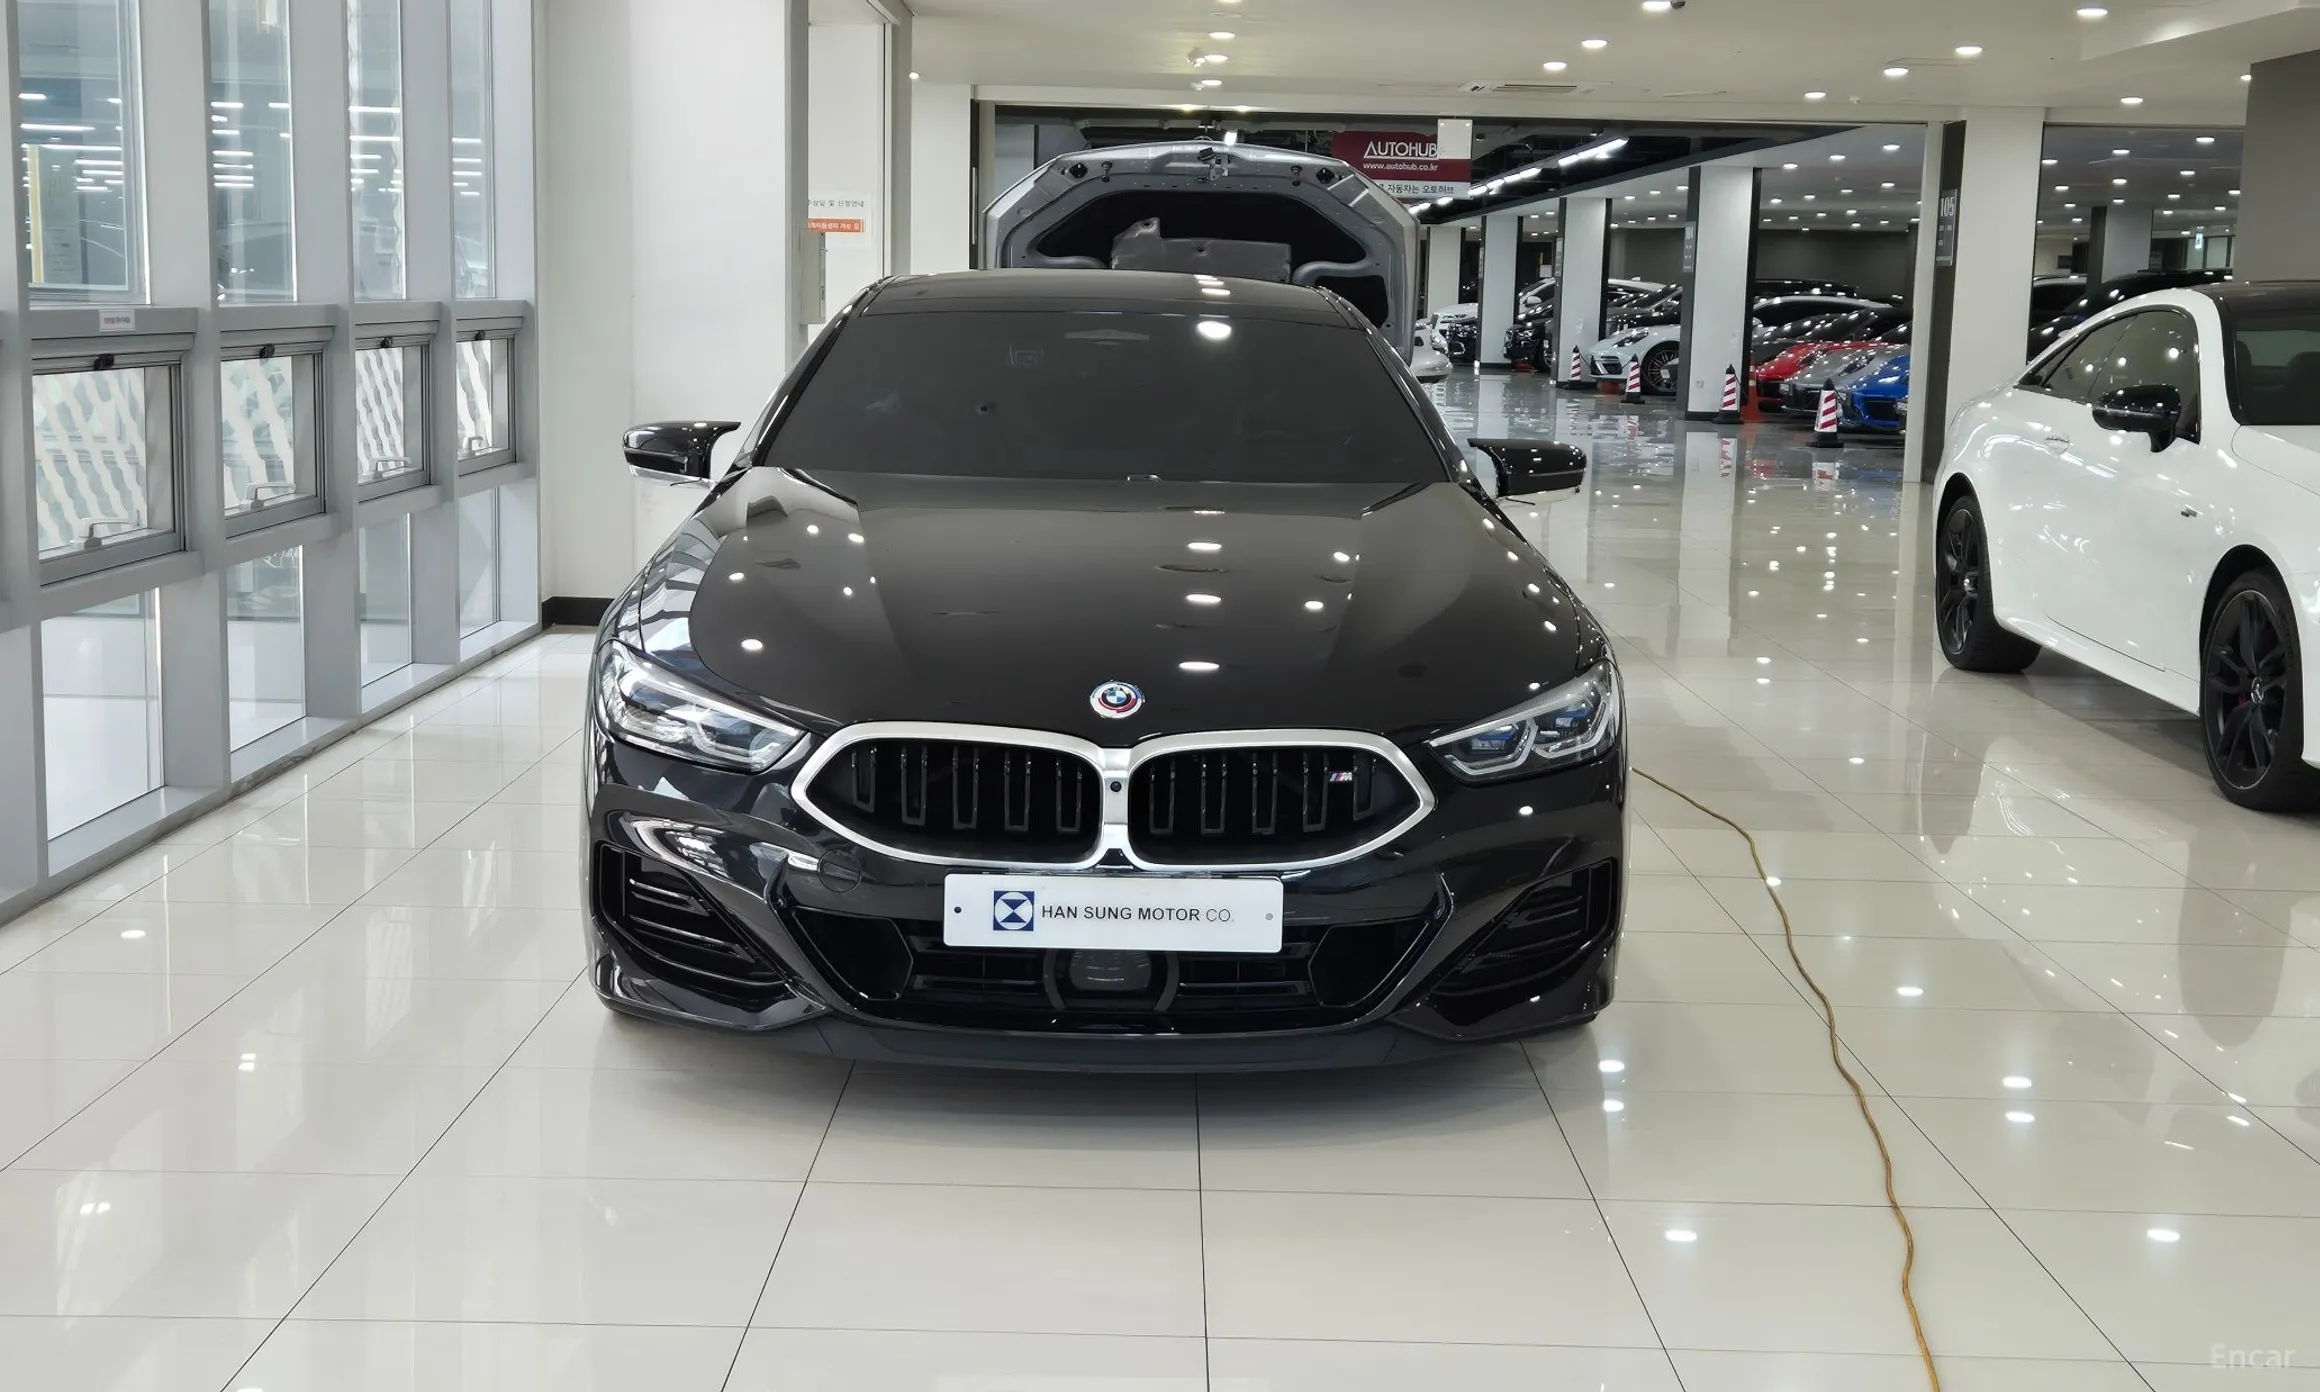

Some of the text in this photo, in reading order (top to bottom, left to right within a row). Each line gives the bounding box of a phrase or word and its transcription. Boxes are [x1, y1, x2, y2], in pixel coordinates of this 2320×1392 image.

[1364, 141, 1438, 158] AUTOHUB
[1363, 162, 1438, 171] www.autohub.co.kr
[1041, 905, 1235, 923] HAN SUNG MOTOR CO.
